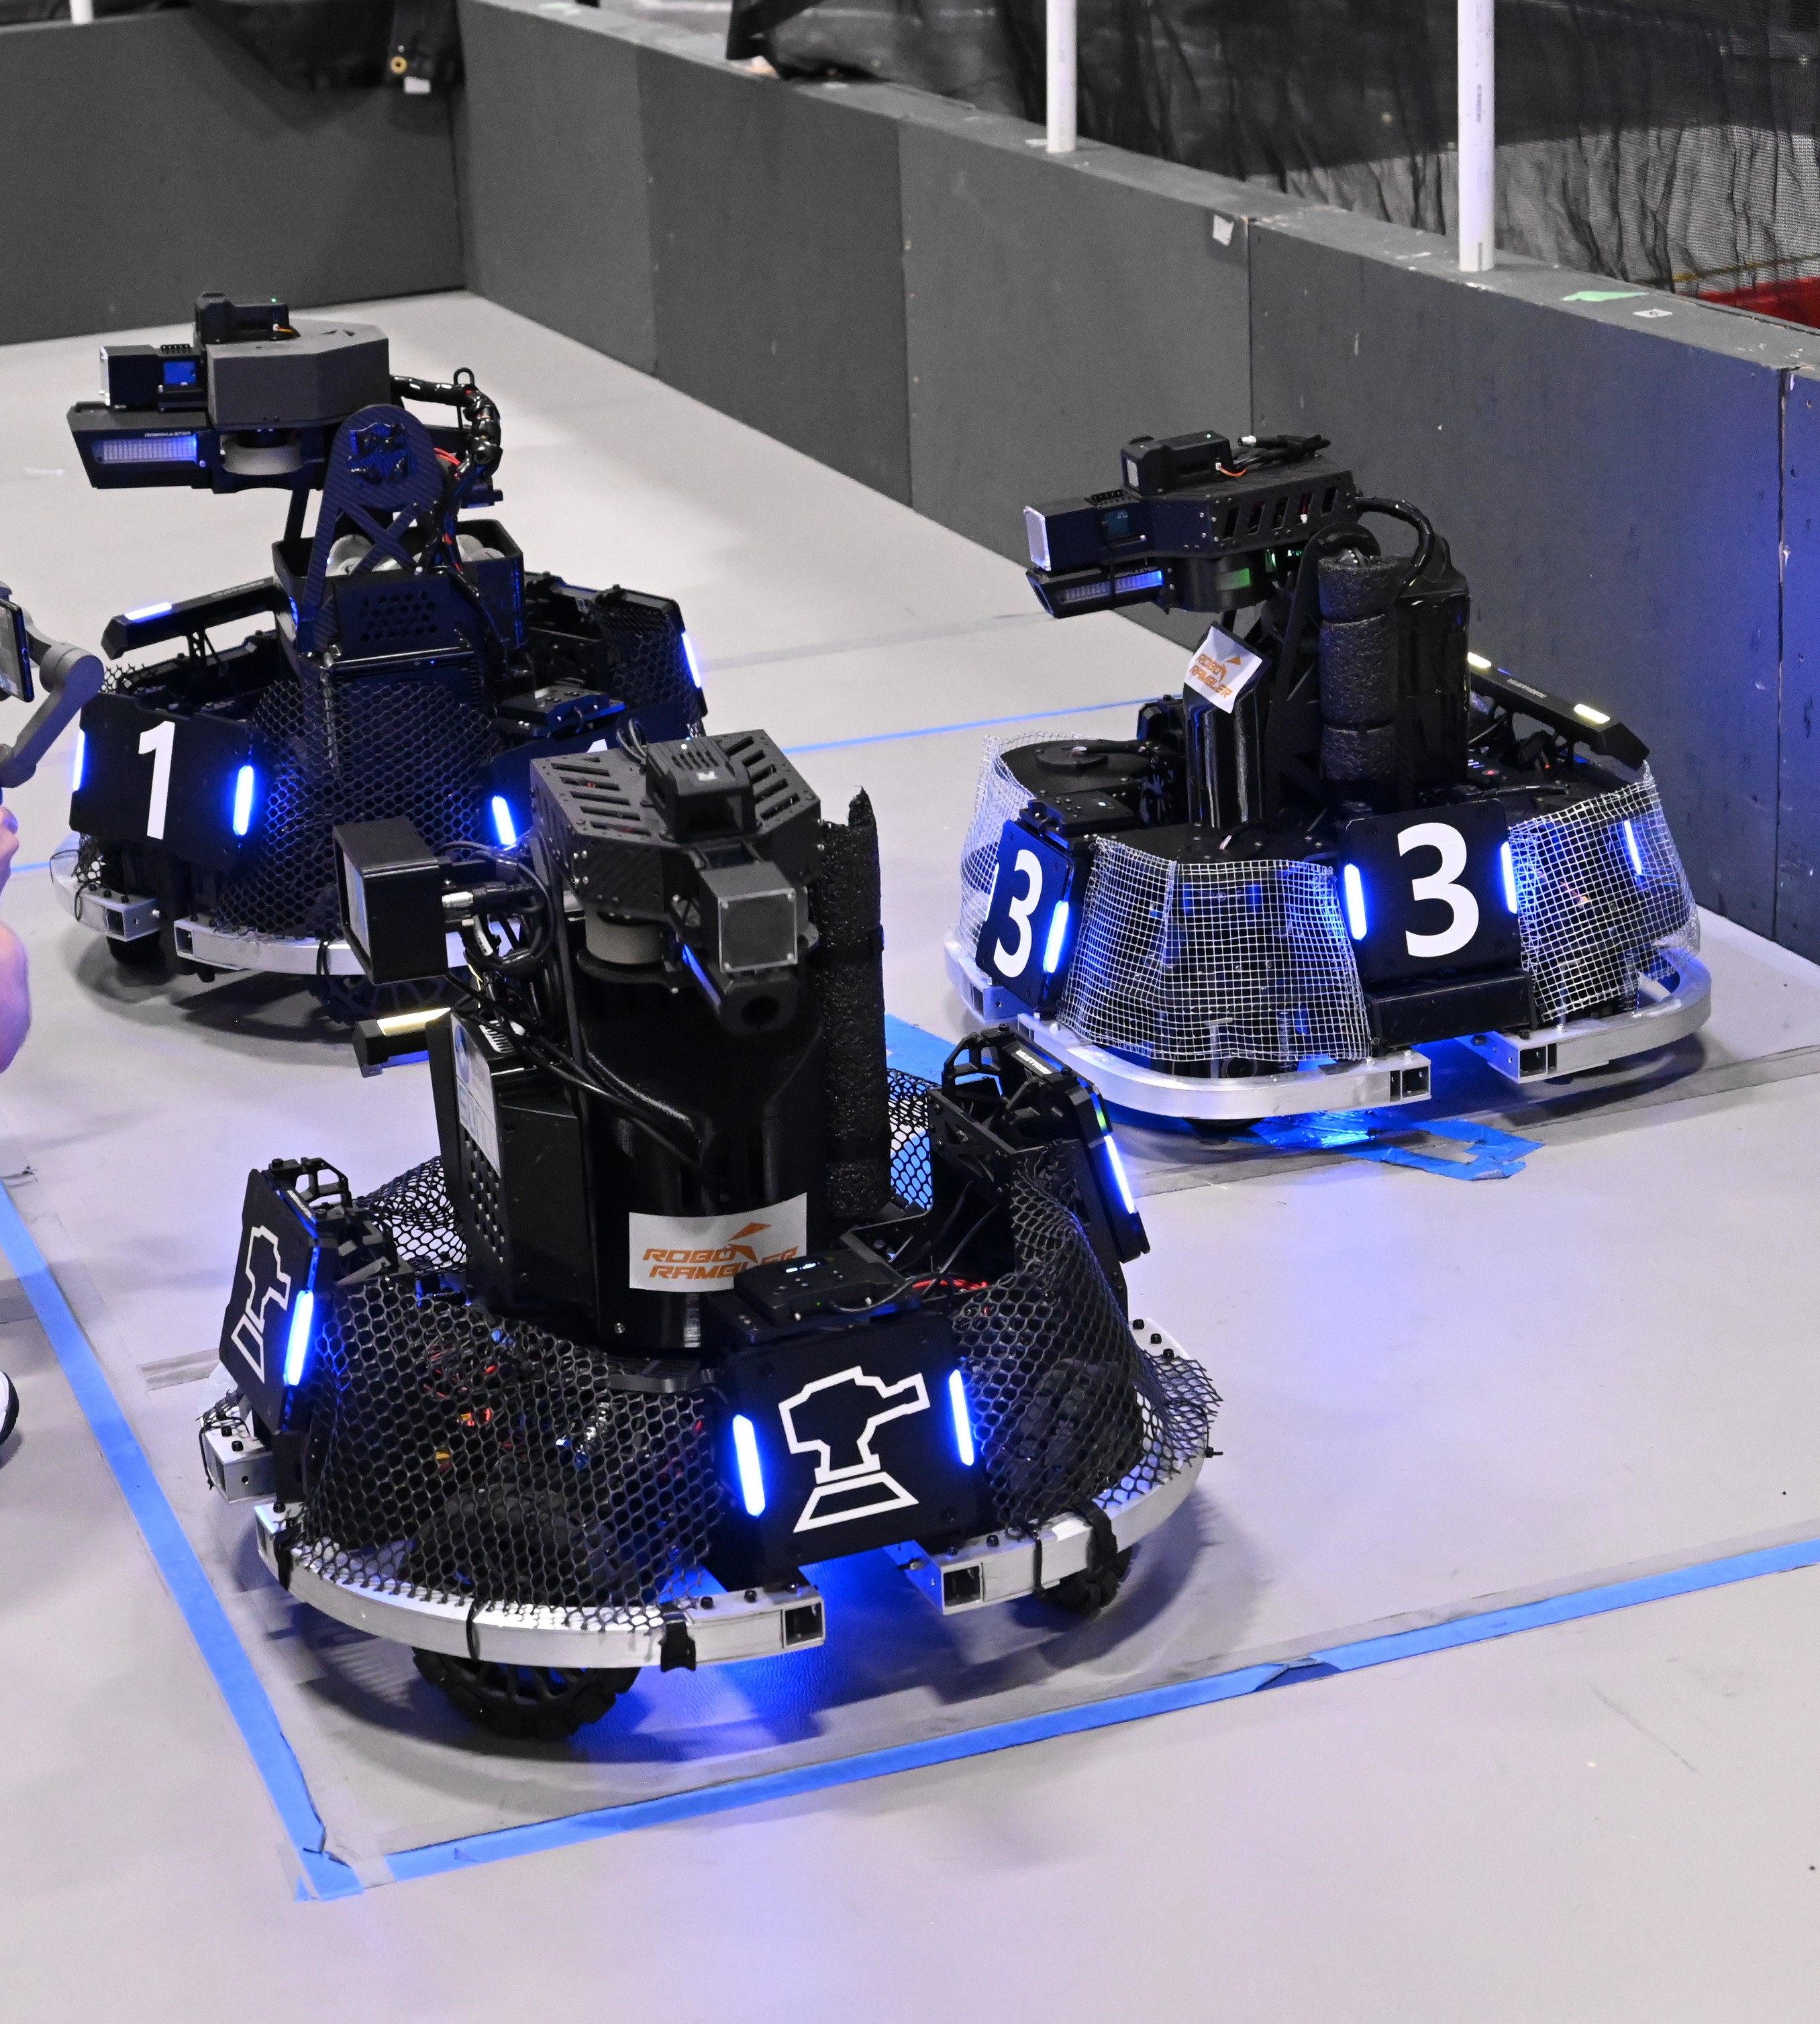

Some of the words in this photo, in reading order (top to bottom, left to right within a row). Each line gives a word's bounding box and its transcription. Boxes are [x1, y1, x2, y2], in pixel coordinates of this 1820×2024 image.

[1189, 665, 1233, 699] RAMBLER
[1195, 653, 1223, 676] ROBO
[138, 720, 176, 840] 1
[993, 849, 1043, 978] 3
[1397, 822, 1479, 958] 3
[642, 1246, 738, 1264] ROBO
